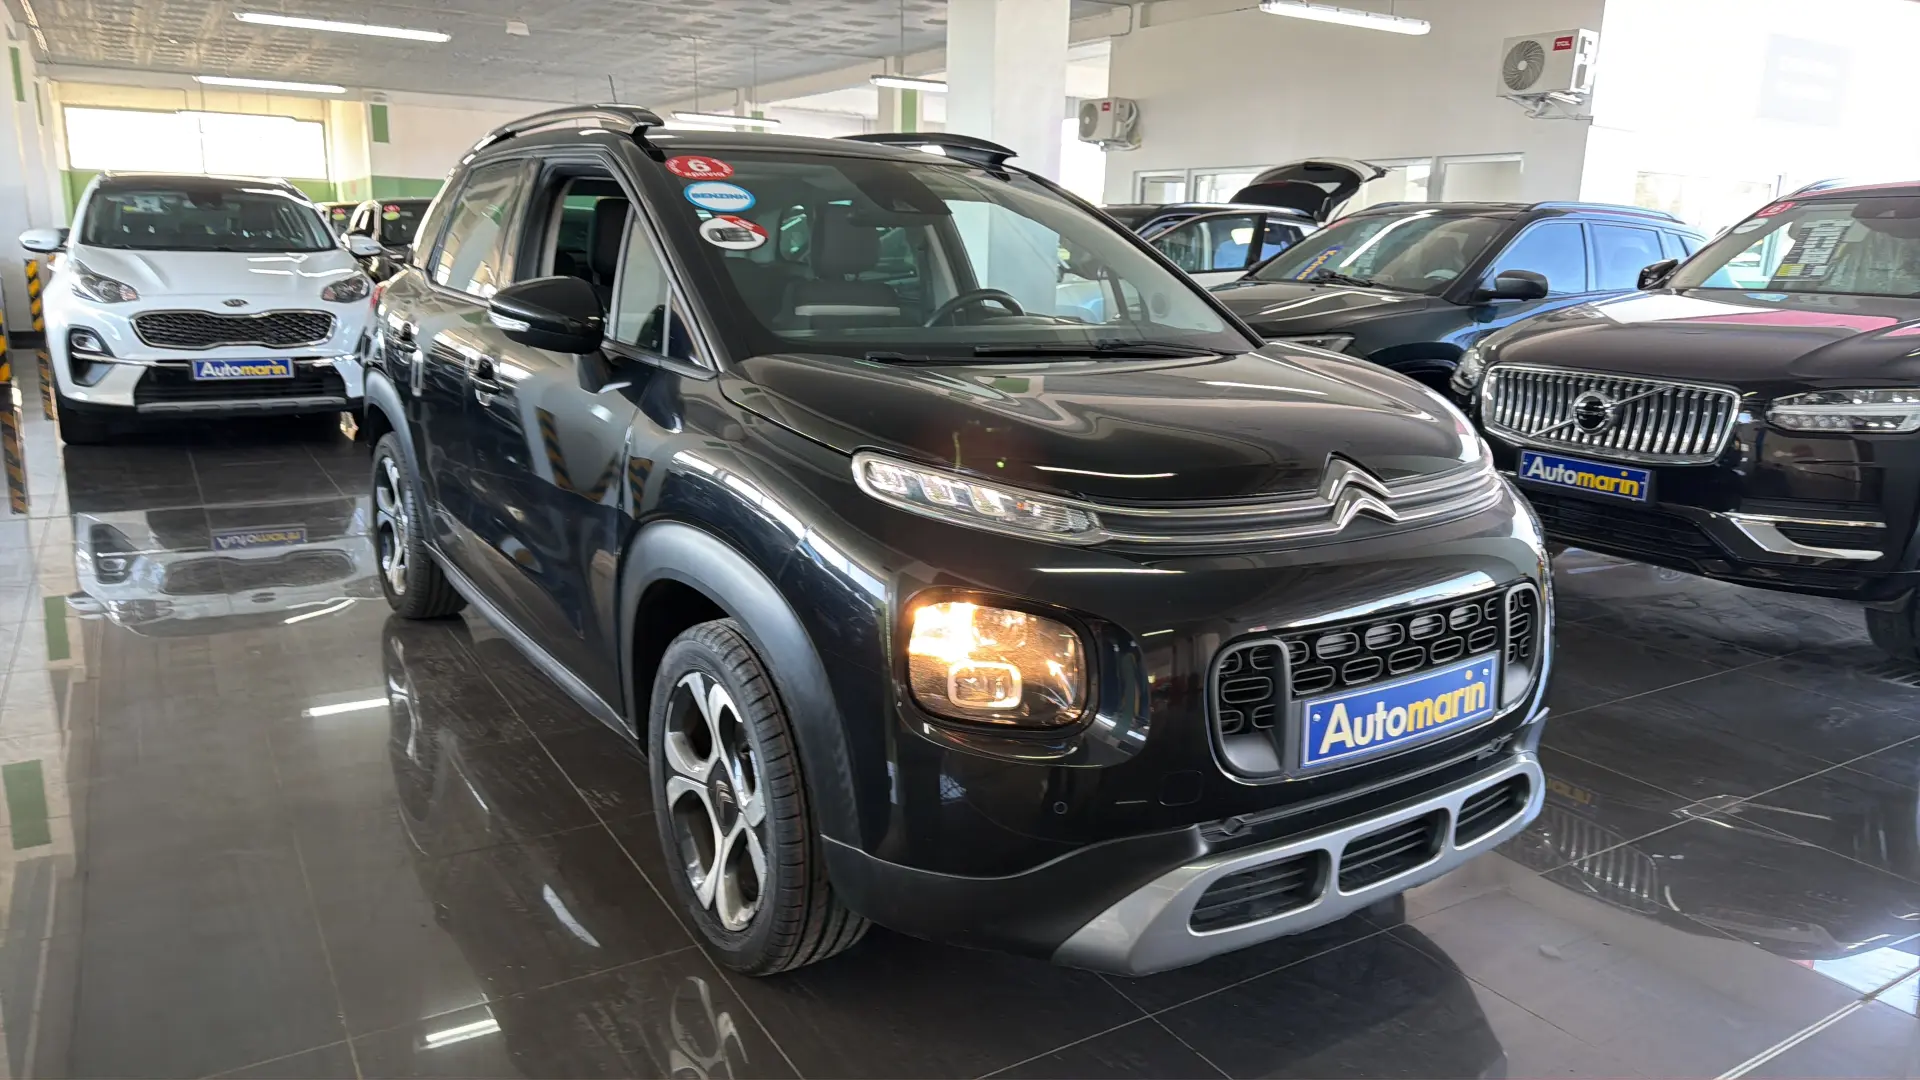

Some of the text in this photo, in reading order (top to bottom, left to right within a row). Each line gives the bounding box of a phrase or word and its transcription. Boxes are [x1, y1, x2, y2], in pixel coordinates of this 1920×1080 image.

[687, 158, 712, 172] 6
[200, 359, 287, 378] Automarin
[1526, 456, 1640, 496] Automarin
[1319, 669, 1486, 755] Automarin
